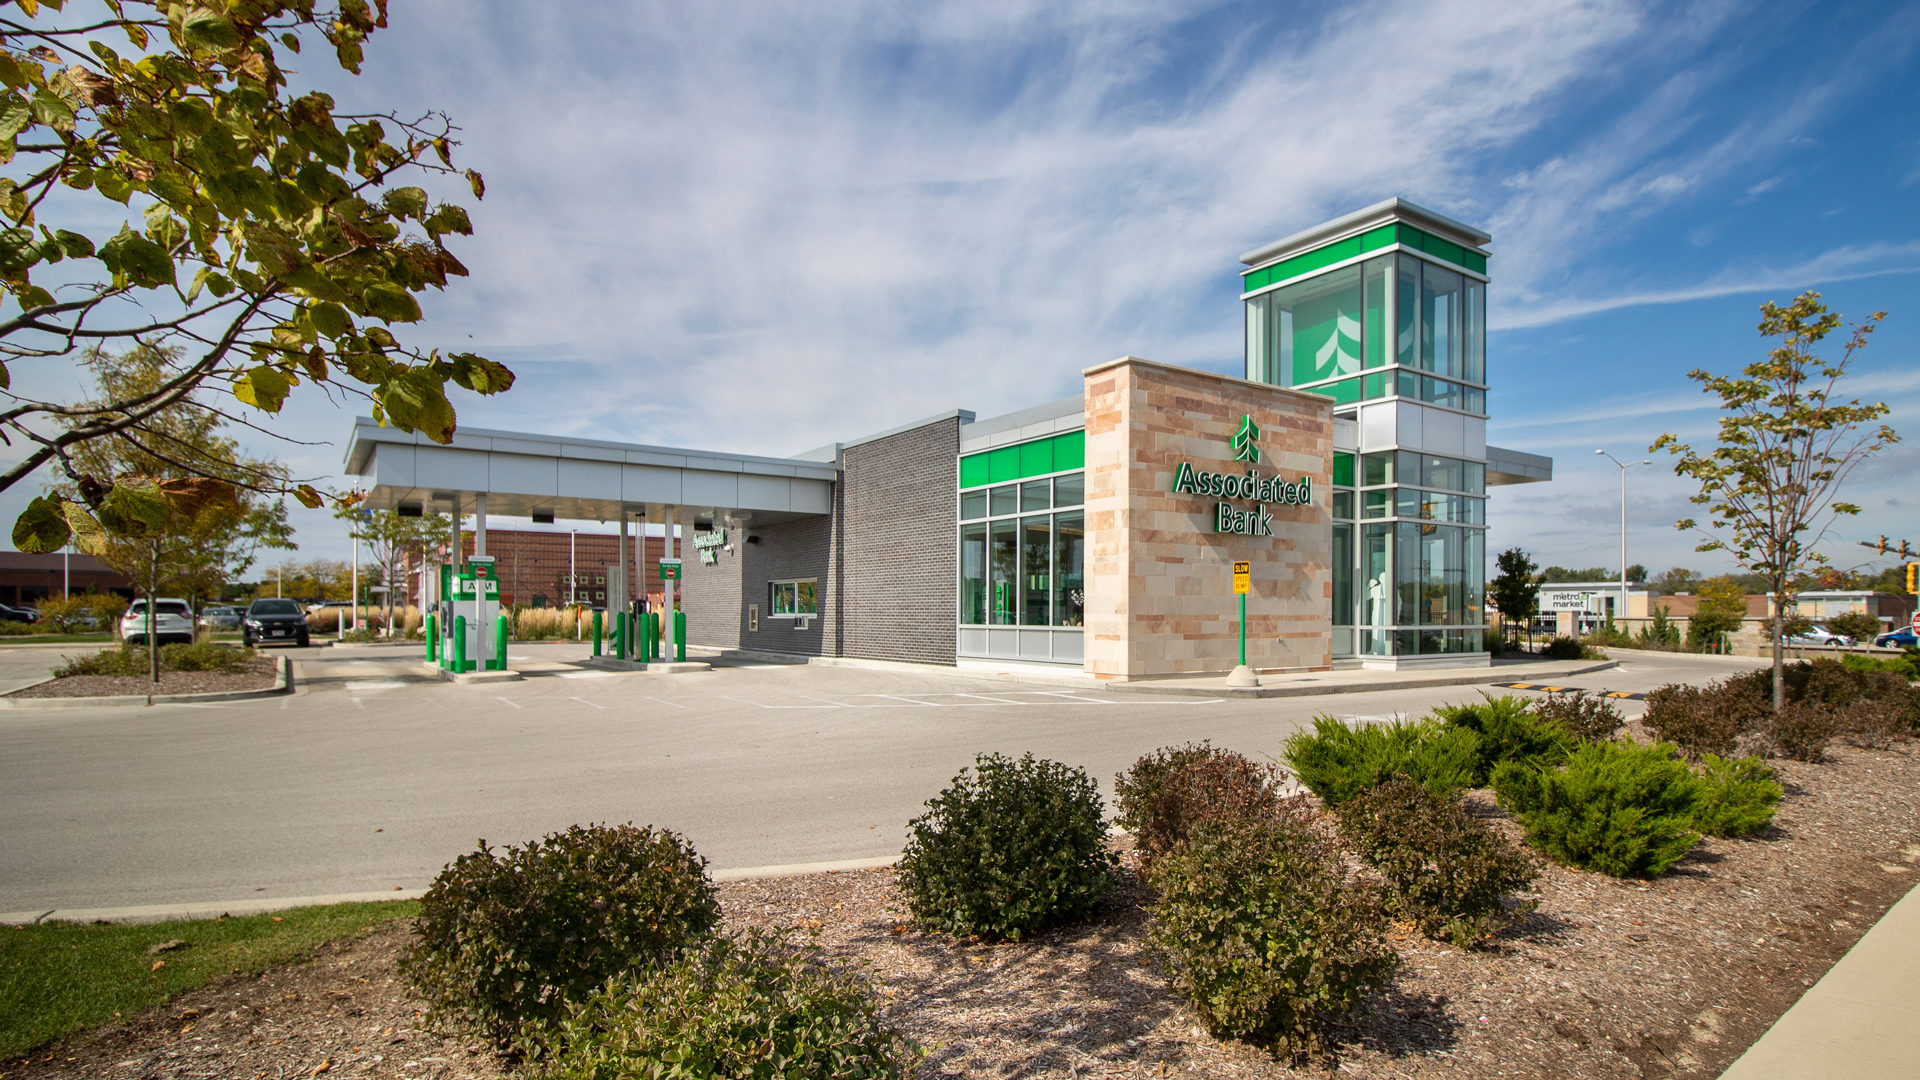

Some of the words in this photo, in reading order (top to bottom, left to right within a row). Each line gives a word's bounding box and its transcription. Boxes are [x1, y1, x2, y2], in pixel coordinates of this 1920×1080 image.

[1172, 462, 1313, 505] Associated
[1215, 502, 1274, 536] Bank
[1235, 564, 1249, 573] SLOW
[468, 582, 492, 591] AM
